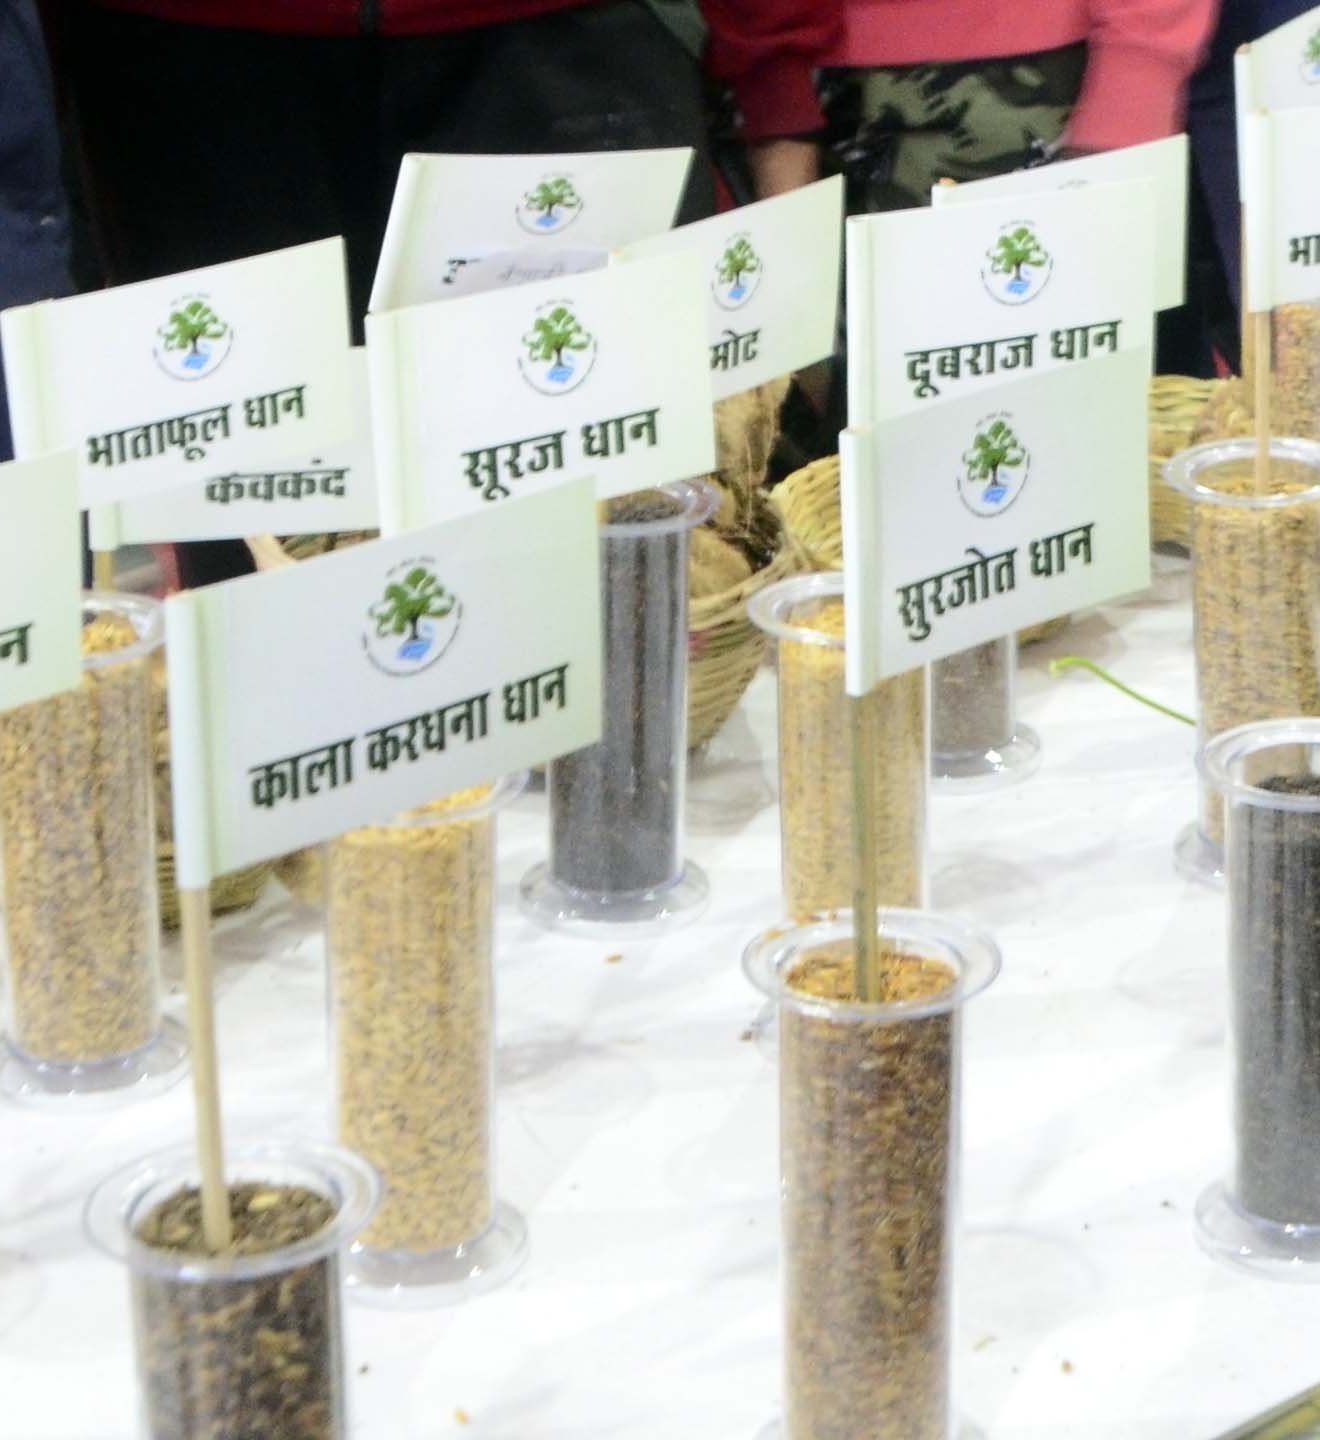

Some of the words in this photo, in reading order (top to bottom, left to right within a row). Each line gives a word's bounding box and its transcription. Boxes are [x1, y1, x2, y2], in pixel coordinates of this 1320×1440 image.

[903, 333, 1040, 398] दूबराज
[1050, 318, 1123, 362] धान
[85, 403, 233, 468] भाताफूल
[243, 384, 307, 429] धान
[460, 429, 567, 502] सूरज
[580, 407, 661, 460] धान
[895, 547, 1019, 642] सुरजोत
[1028, 522, 1096, 578] धान
[247, 737, 357, 811] काला
[364, 691, 492, 773] करधना
[503, 661, 571, 725] धान
